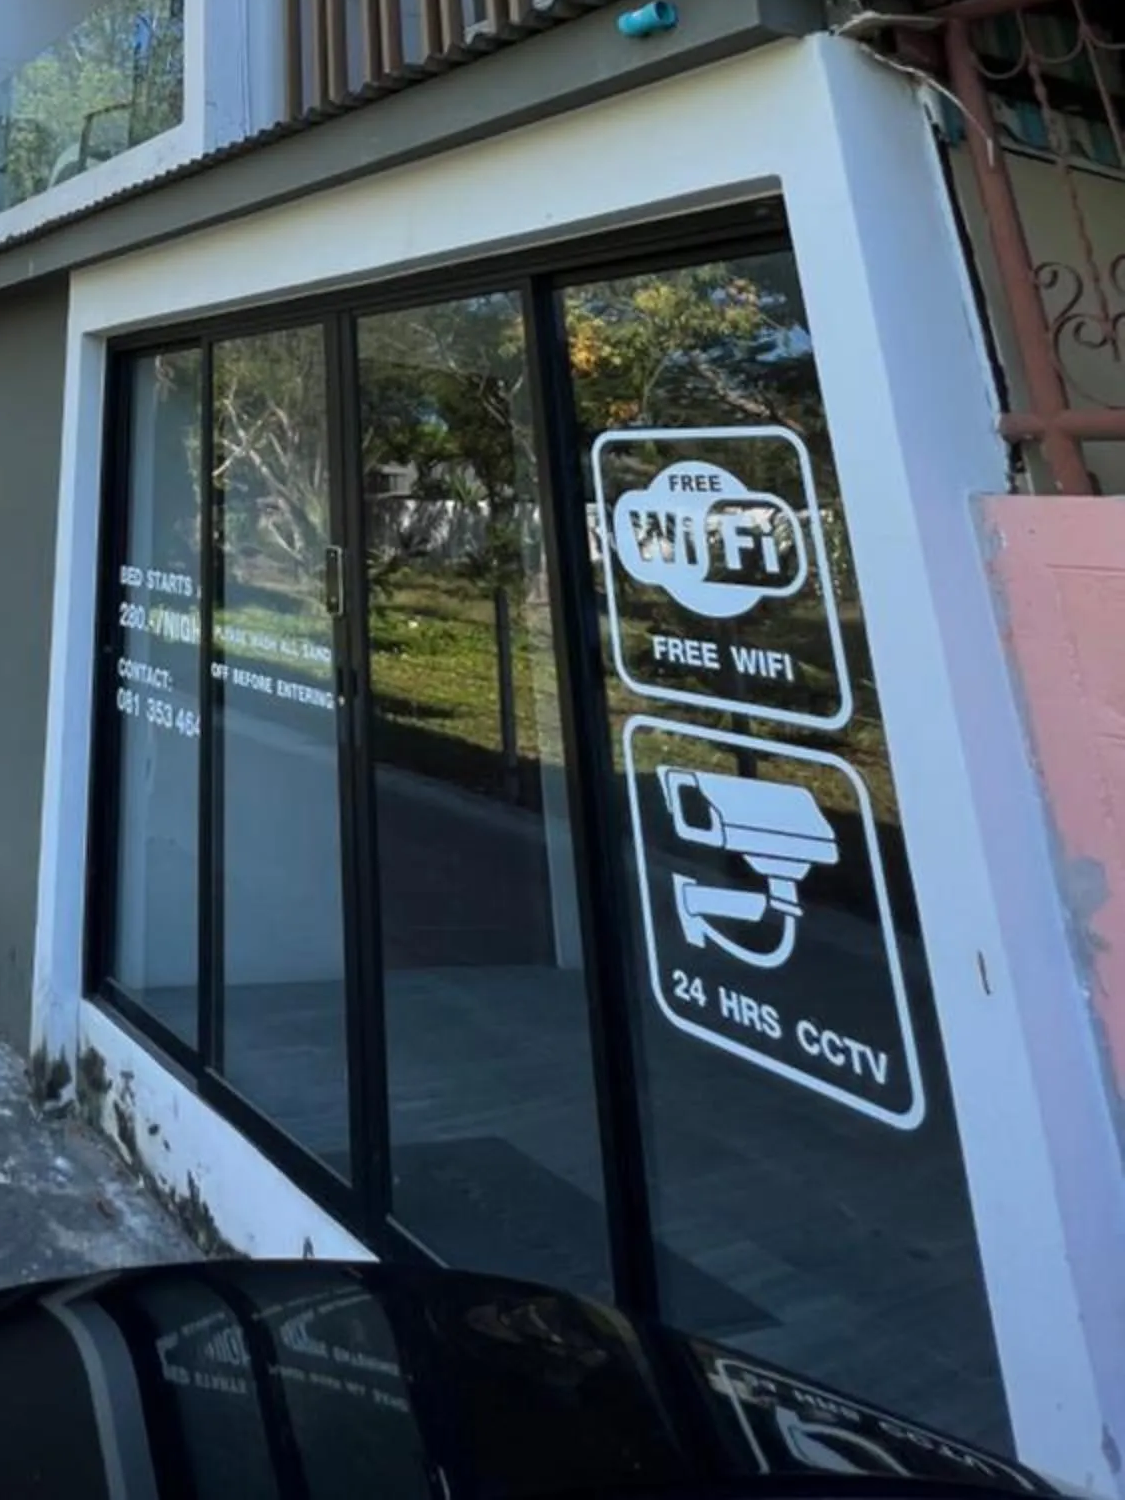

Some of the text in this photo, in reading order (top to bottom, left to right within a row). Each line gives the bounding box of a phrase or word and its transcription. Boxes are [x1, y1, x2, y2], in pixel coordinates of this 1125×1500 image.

[668, 474, 723, 493] FREE
[119, 565, 143, 587] BED
[146, 569, 194, 597] STARTS
[117, 657, 174, 693] CONTACT:
[652, 634, 794, 682] FREE WIFI
[211, 661, 335, 710] OFF BEFORE ENTERING
[672, 969, 888, 1085] 24 HRS CCTV
